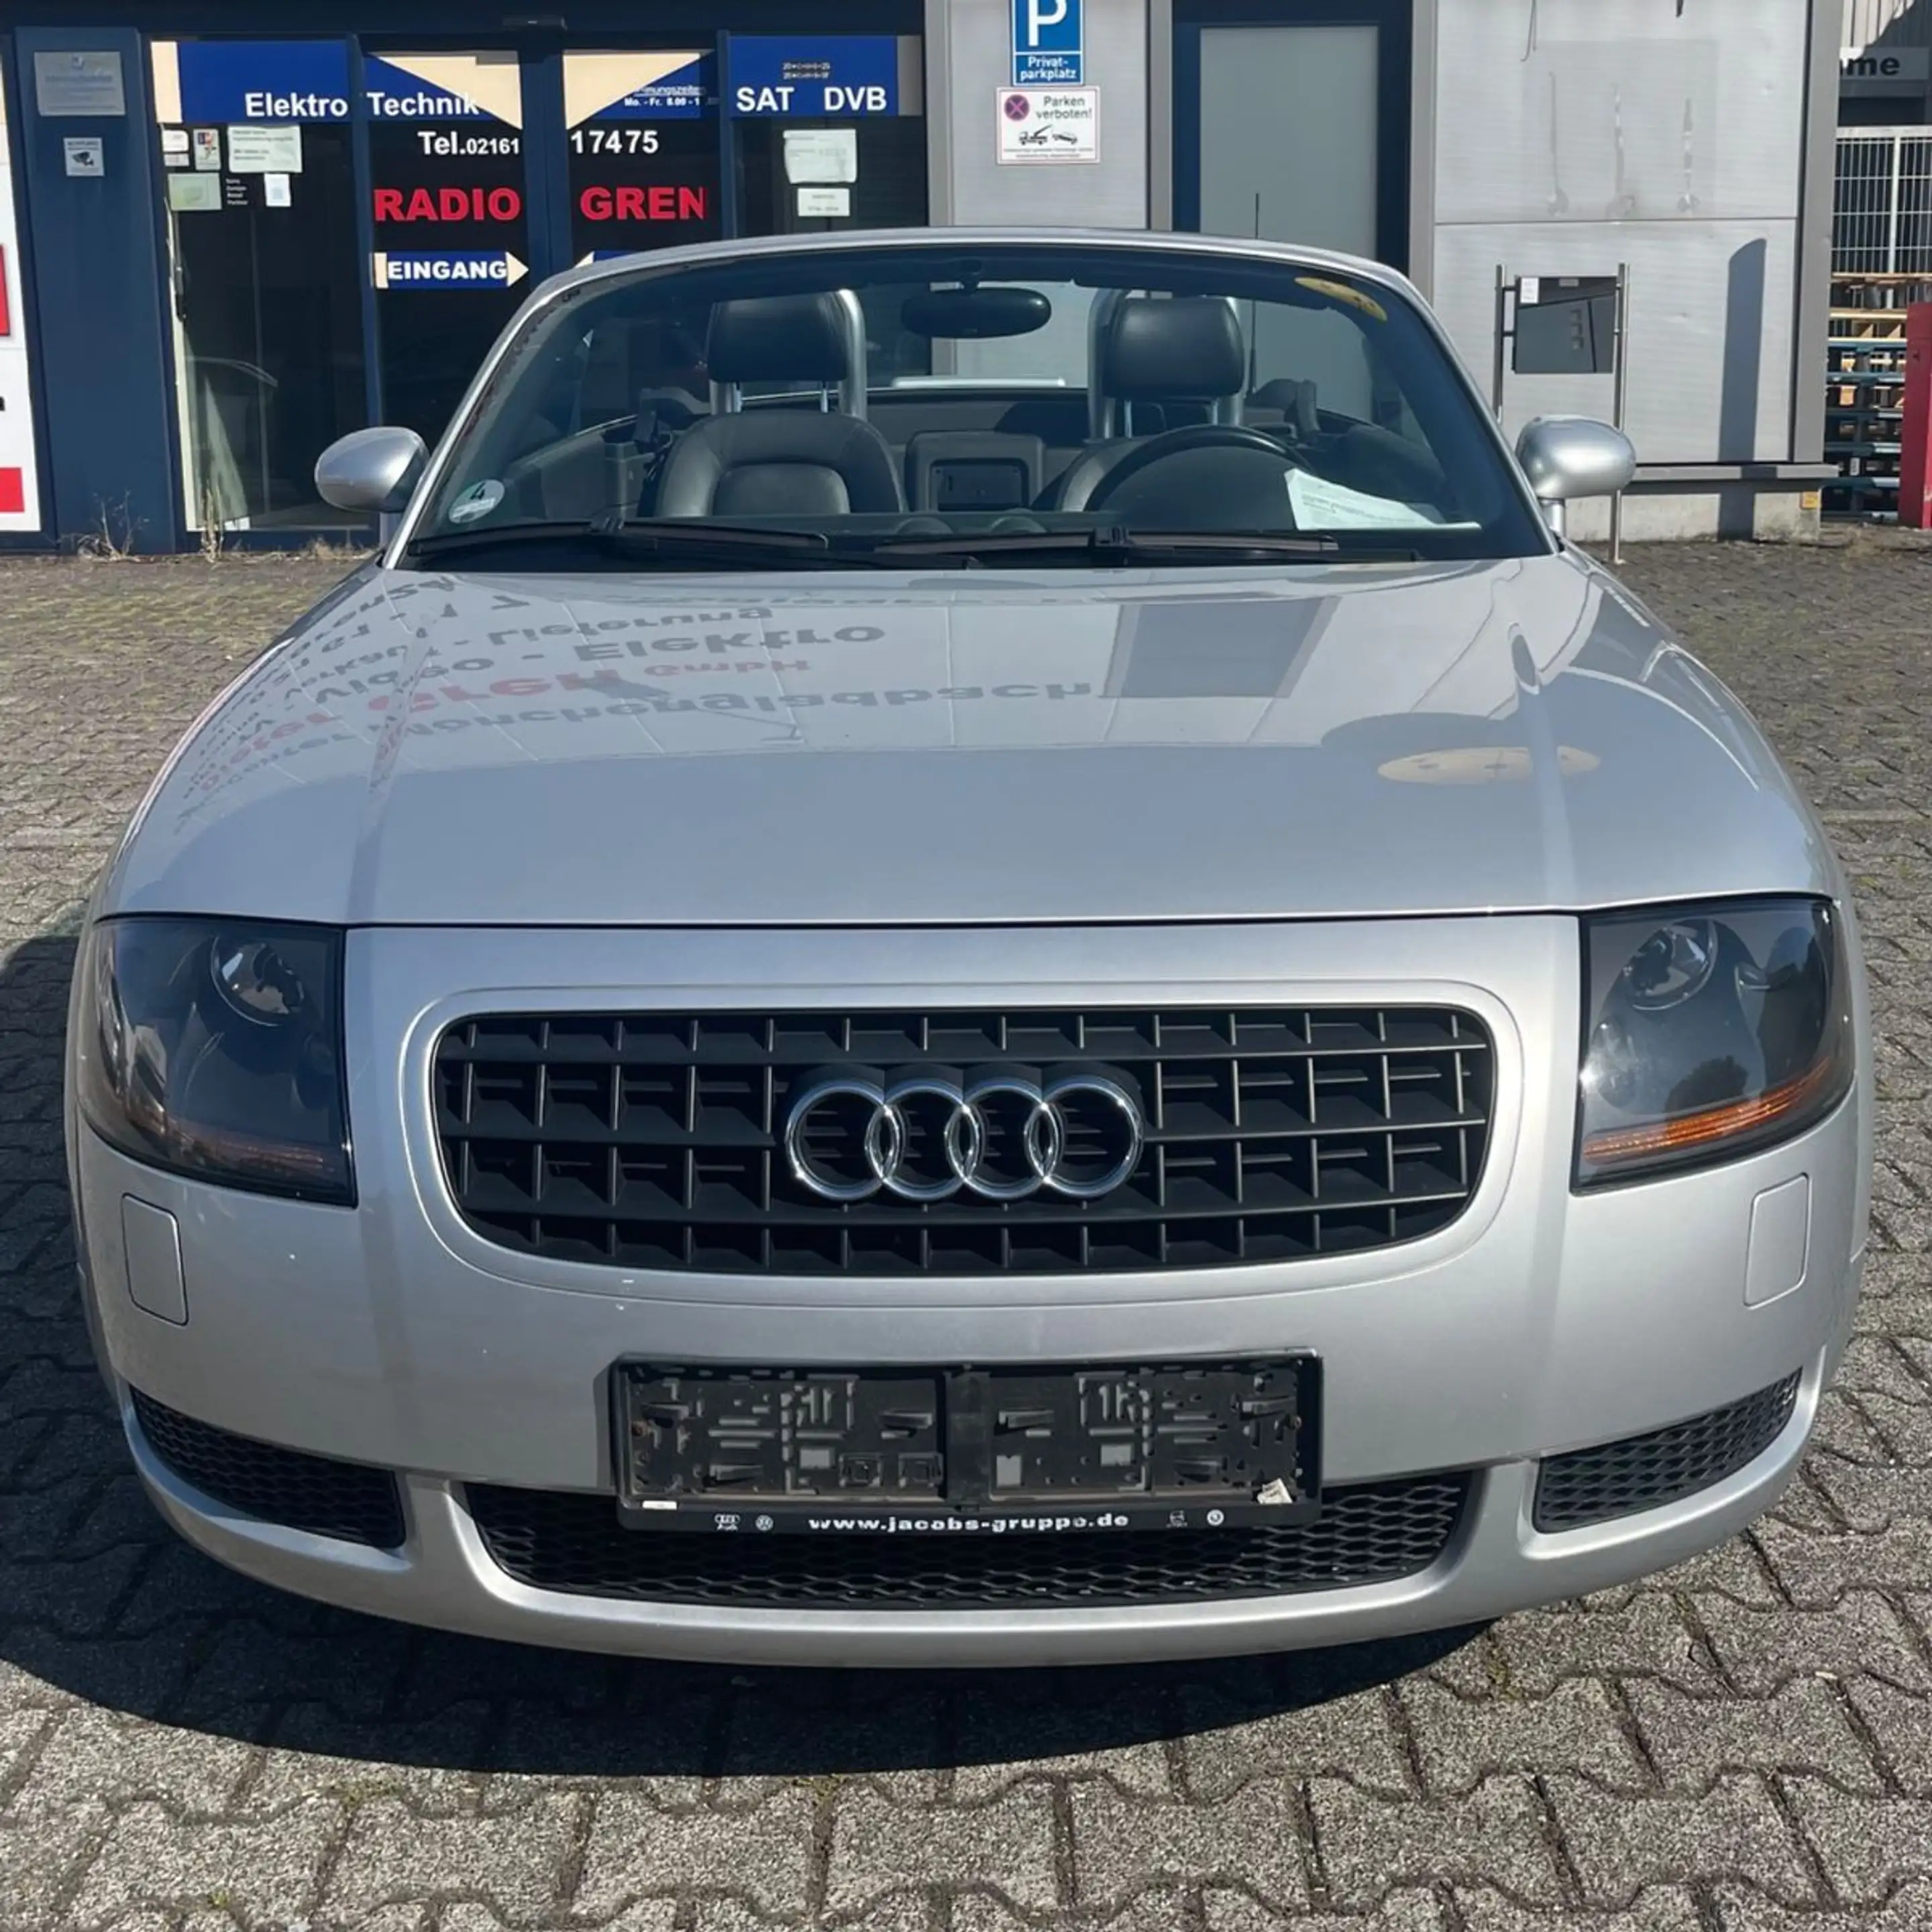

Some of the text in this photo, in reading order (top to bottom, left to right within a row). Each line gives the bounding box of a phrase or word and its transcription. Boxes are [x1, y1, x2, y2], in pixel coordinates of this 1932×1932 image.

[1028, 0, 1067, 46] P
[1028, 56, 1069, 68] Privat-
[1839, 56, 1900, 76] me
[1020, 68, 1077, 81] parkplatz
[245, 92, 479, 117] Elektro Technik
[736, 87, 887, 111] SAT DVB
[1043, 95, 1085, 107] Parken
[1036, 109, 1092, 119] verboten!
[374, 186, 704, 221] RADIO GREN
[387, 260, 508, 280] EINGANG
